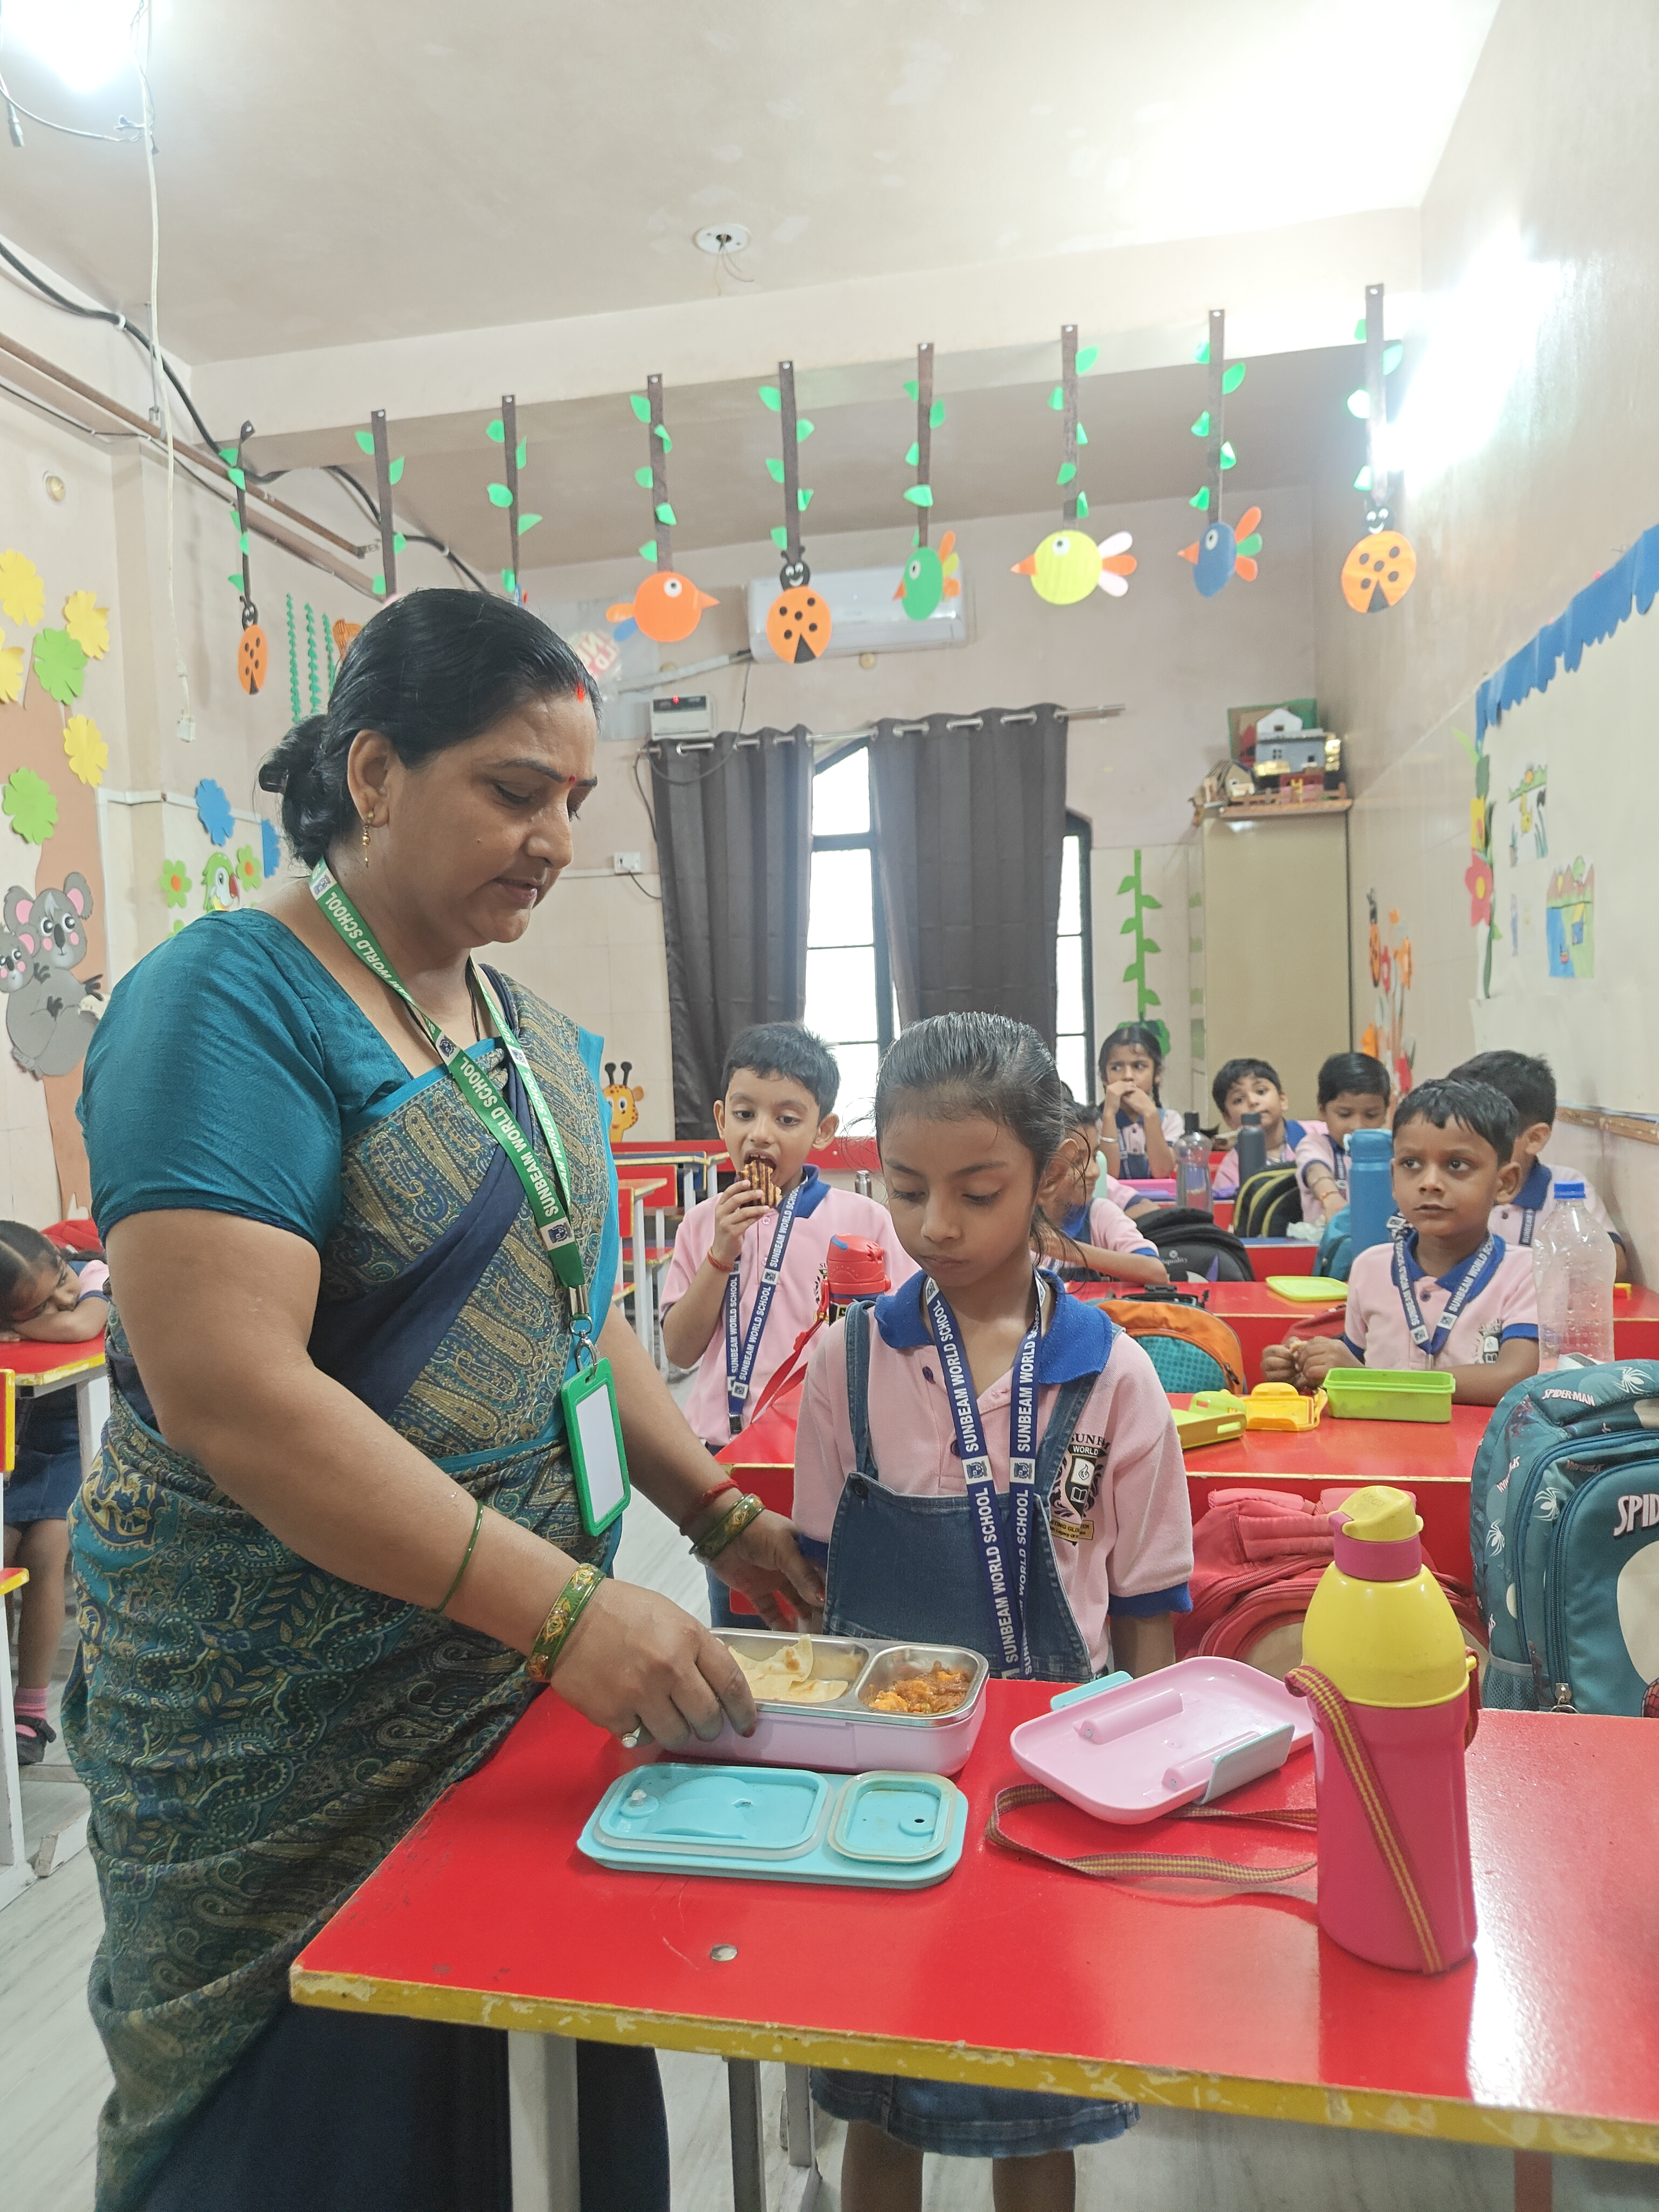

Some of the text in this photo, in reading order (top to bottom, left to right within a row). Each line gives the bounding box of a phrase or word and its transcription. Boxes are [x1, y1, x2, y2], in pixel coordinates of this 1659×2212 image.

[325, 892, 363, 939] SCHOOL
[356, 939, 392, 979] WORLD
[523, 1071, 548, 1116] SCHOOL
[460, 1056, 559, 1217] SUNBEAM WORLD SCHOOL
[542, 1117, 563, 1159] WORLD
[770, 1233, 786, 1268] SUNBEAM
[779, 1210, 792, 1234] WORLD
[1448, 1274, 1476, 1312] SUNBEAM
[1467, 1252, 1488, 1278] WORLD
[1403, 1289, 1420, 1326] SUNBEAM
[731, 1336, 739, 1374] SUNBEAM
[739, 1286, 772, 1381] SUNBEAM WORLD SCHOOL
[933, 1300, 979, 1452] SUNBEAM WORLD SCHOOL
[1020, 1341, 1036, 1384] WORLD
[1017, 1387, 1033, 1452] SUNBEAM
[1542, 1388, 1595, 1407] SPIDER-MAN
[1073, 1445, 1098, 1456] WORLD
[1016, 1489, 1028, 1545] SCHOOL
[975, 1487, 1019, 1664] SUNBEAM WORLD SCHOOL
